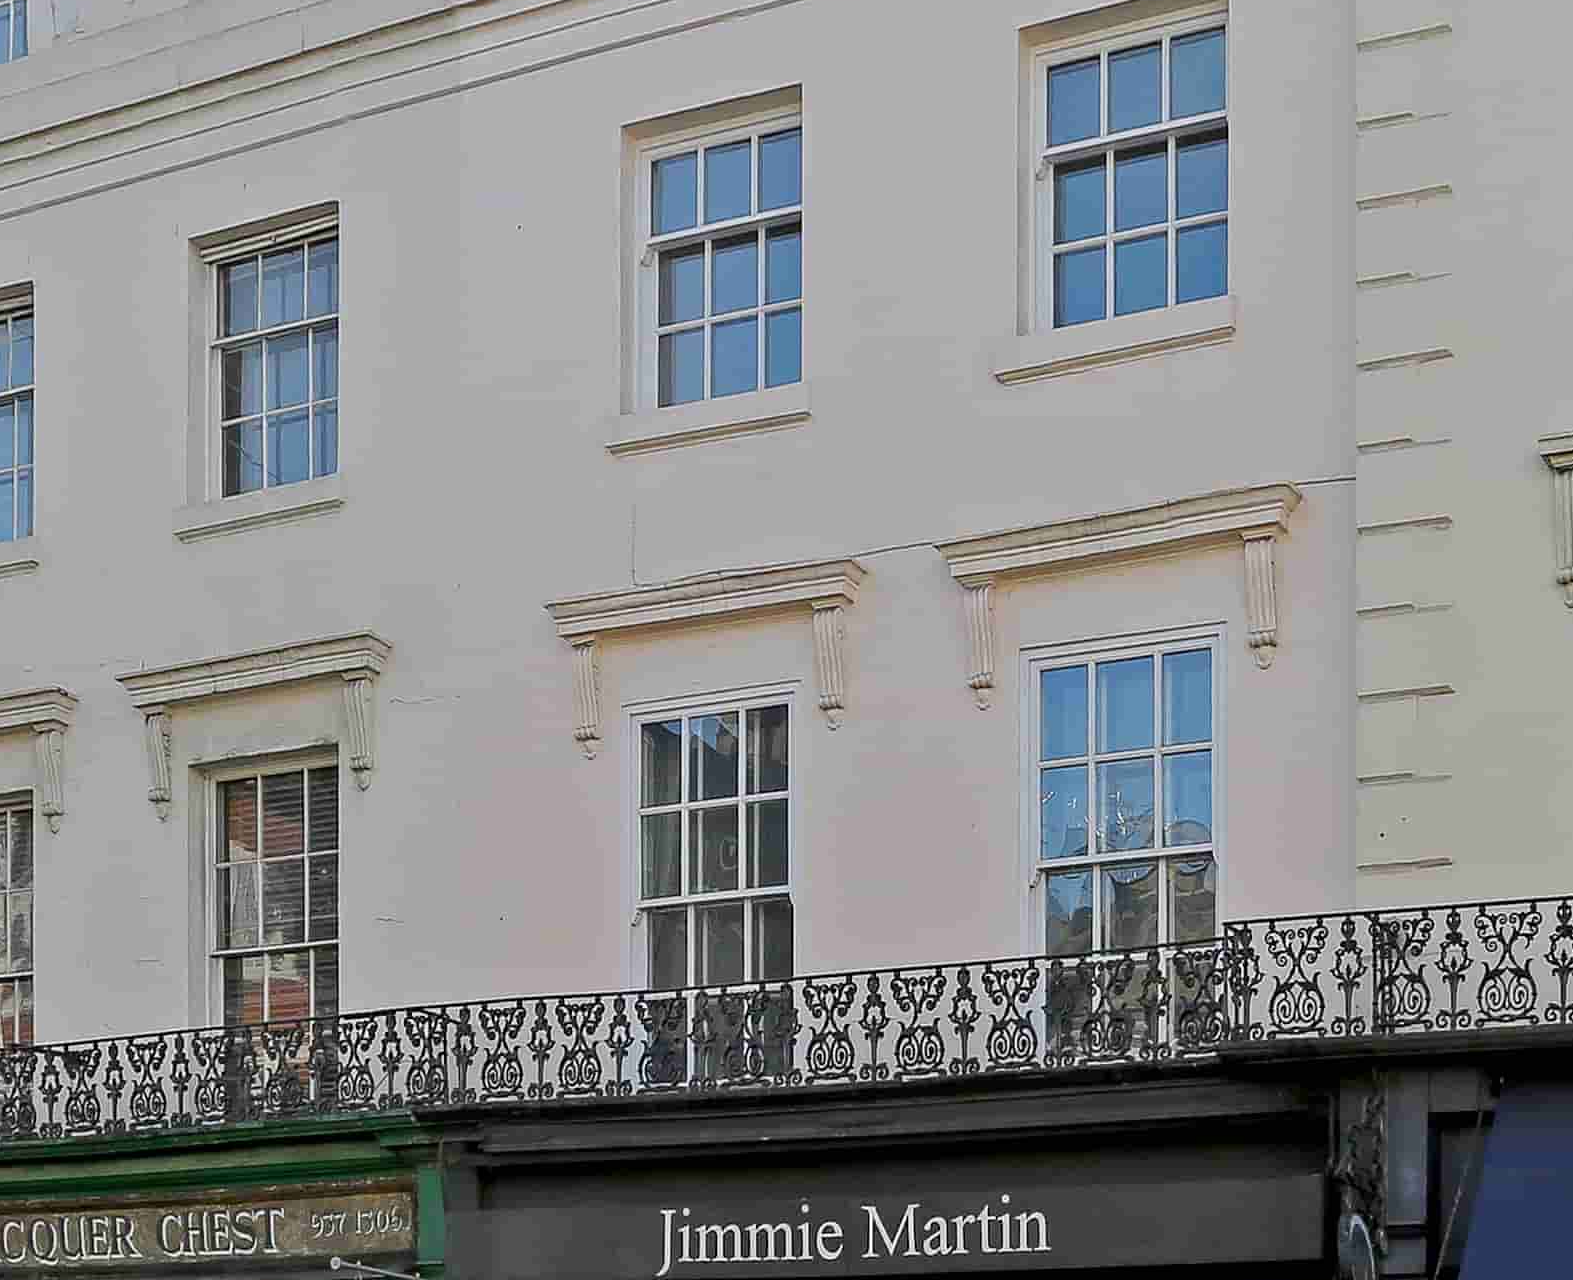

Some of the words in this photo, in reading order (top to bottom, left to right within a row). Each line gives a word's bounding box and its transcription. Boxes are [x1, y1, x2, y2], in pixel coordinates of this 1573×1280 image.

[161, 1207, 285, 1258] CHEST
[655, 1204, 844, 1278] Jimmie
[861, 1193, 1052, 1259] Martin
